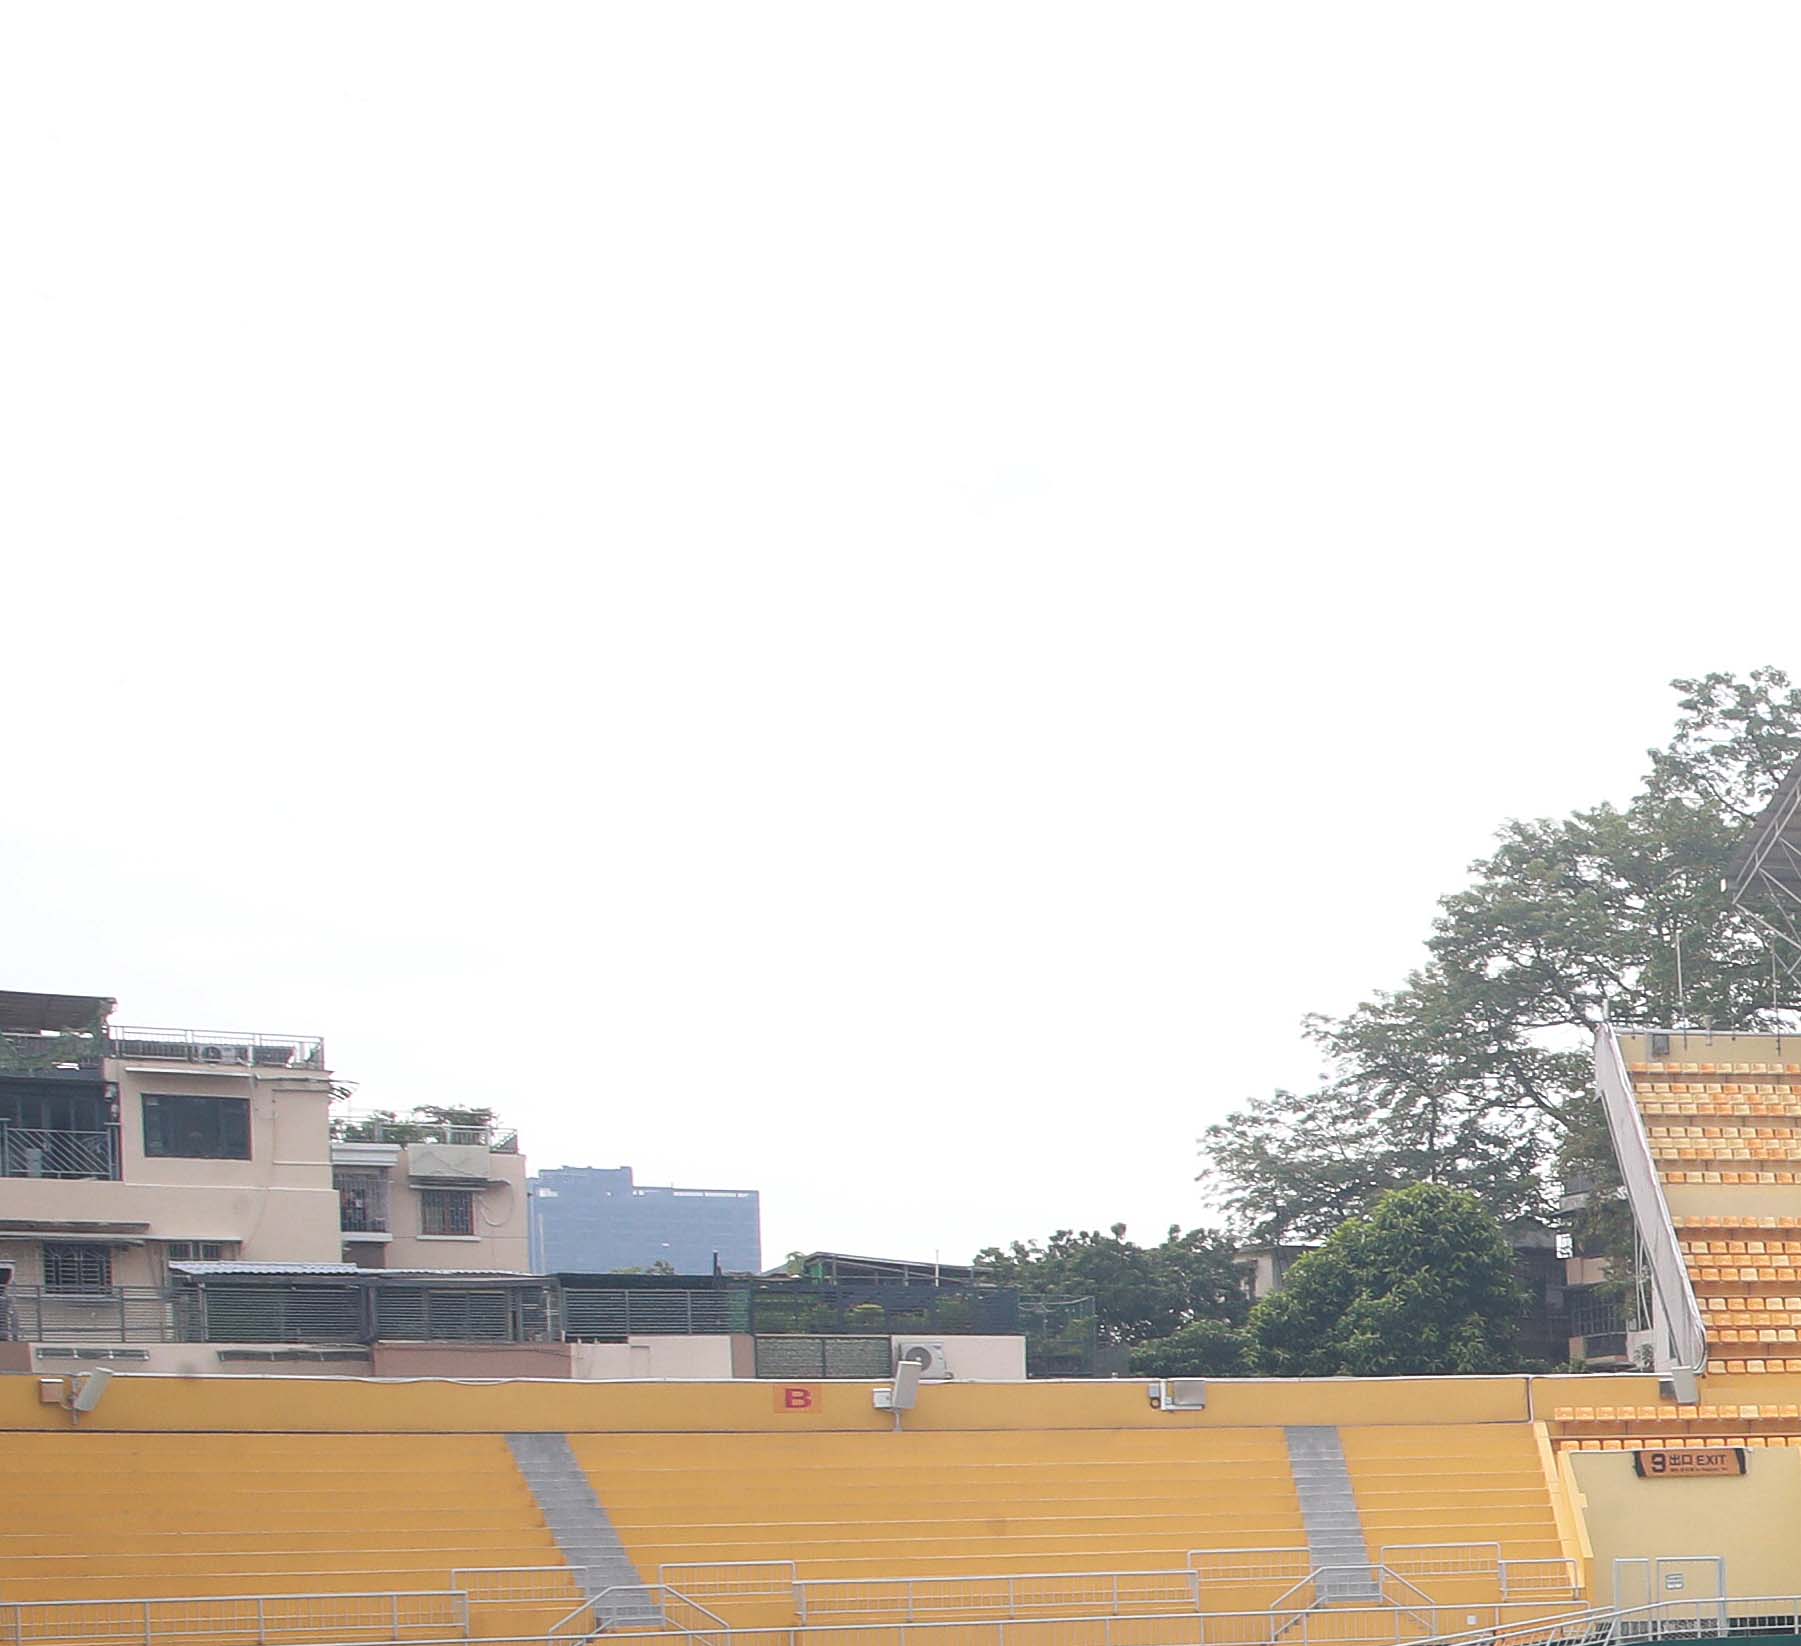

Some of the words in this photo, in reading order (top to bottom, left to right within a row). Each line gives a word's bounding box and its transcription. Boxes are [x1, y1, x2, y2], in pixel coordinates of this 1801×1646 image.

[785, 1388, 812, 1408] B
[1651, 1453, 1666, 1473] 9
[1669, 1454, 1694, 1466] 出口
[1696, 1454, 1728, 1466] EXIT
